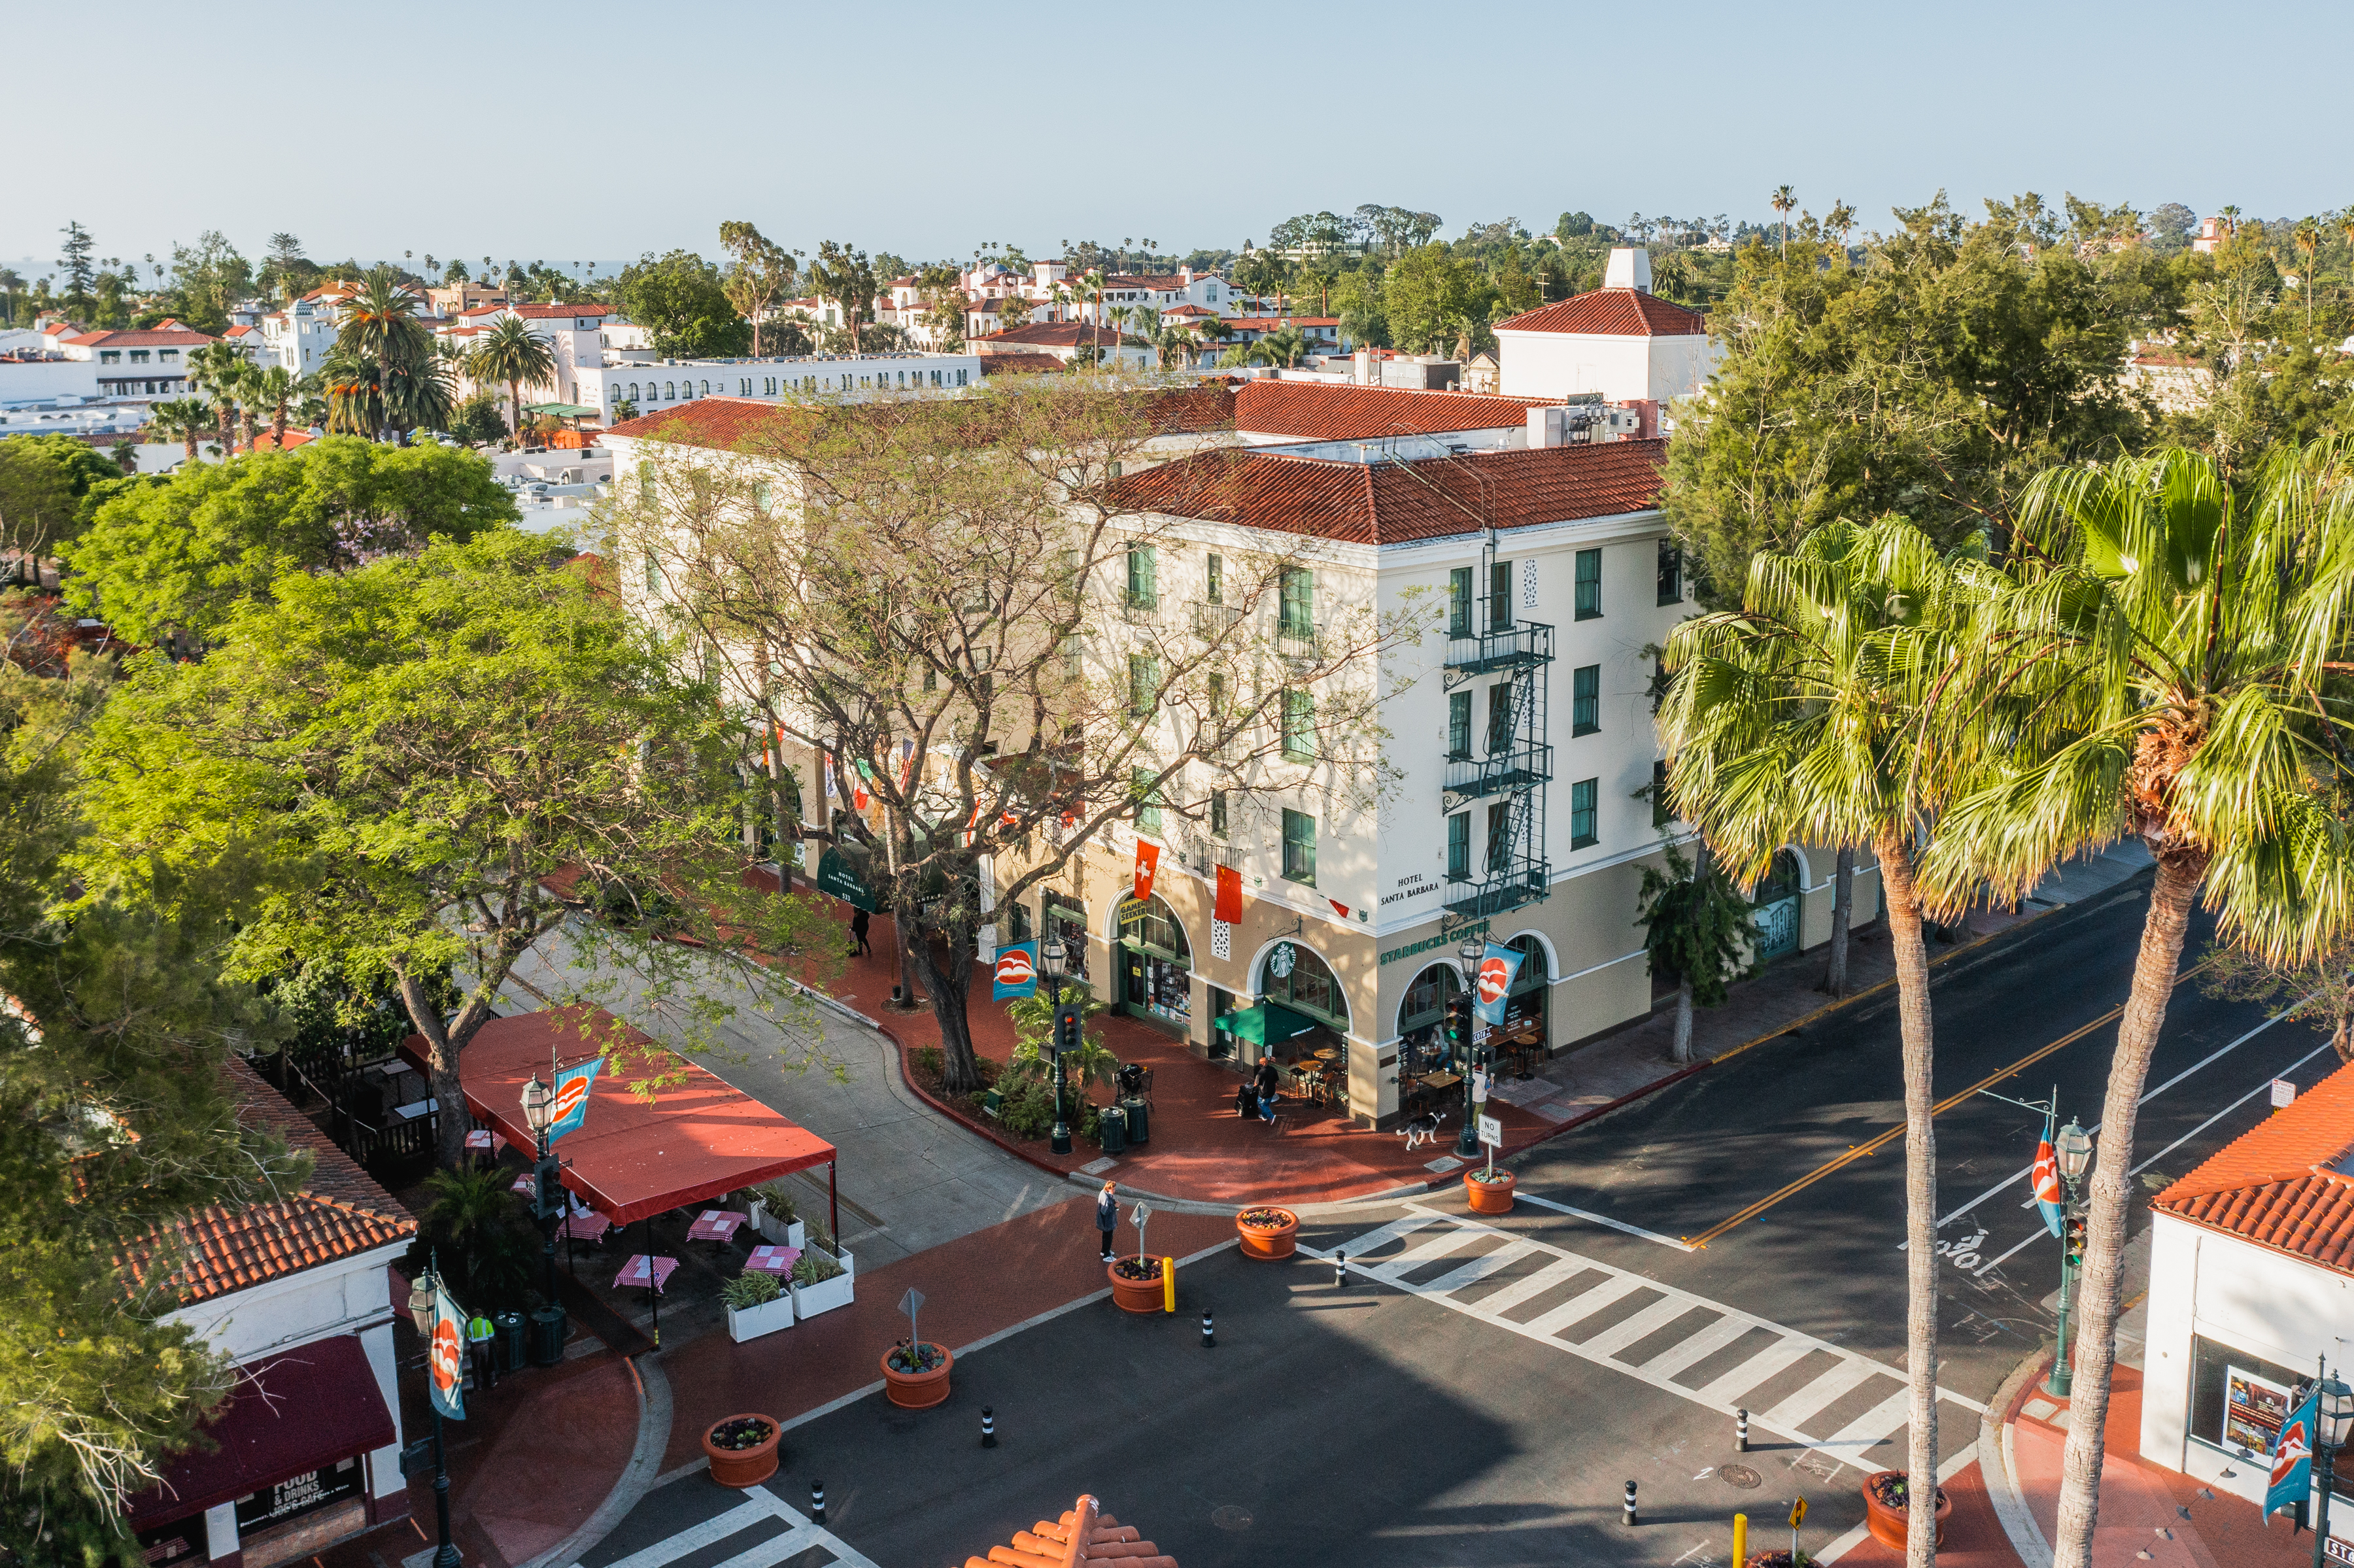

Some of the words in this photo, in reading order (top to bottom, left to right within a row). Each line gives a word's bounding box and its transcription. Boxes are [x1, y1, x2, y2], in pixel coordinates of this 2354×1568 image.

[828, 874, 843, 884] SANTA
[838, 871, 853, 882] HOTEL
[1397, 873, 1423, 887] HOTEL
[842, 893, 851, 902] 533
[1380, 892, 1405, 906] SANTA
[1407, 882, 1439, 898] BARBARA
[1121, 901, 1142, 913] GAME
[1121, 908, 1146, 921] SEEKER
[1380, 933, 1448, 966] STARBUCKS
[1449, 919, 1491, 943] COFFEE
[1474, 1029, 1486, 1041] COTA
[1484, 1121, 1494, 1131] NO
[1480, 1130, 1499, 1142] TURNS
[284, 1480, 320, 1502] DRINKS
